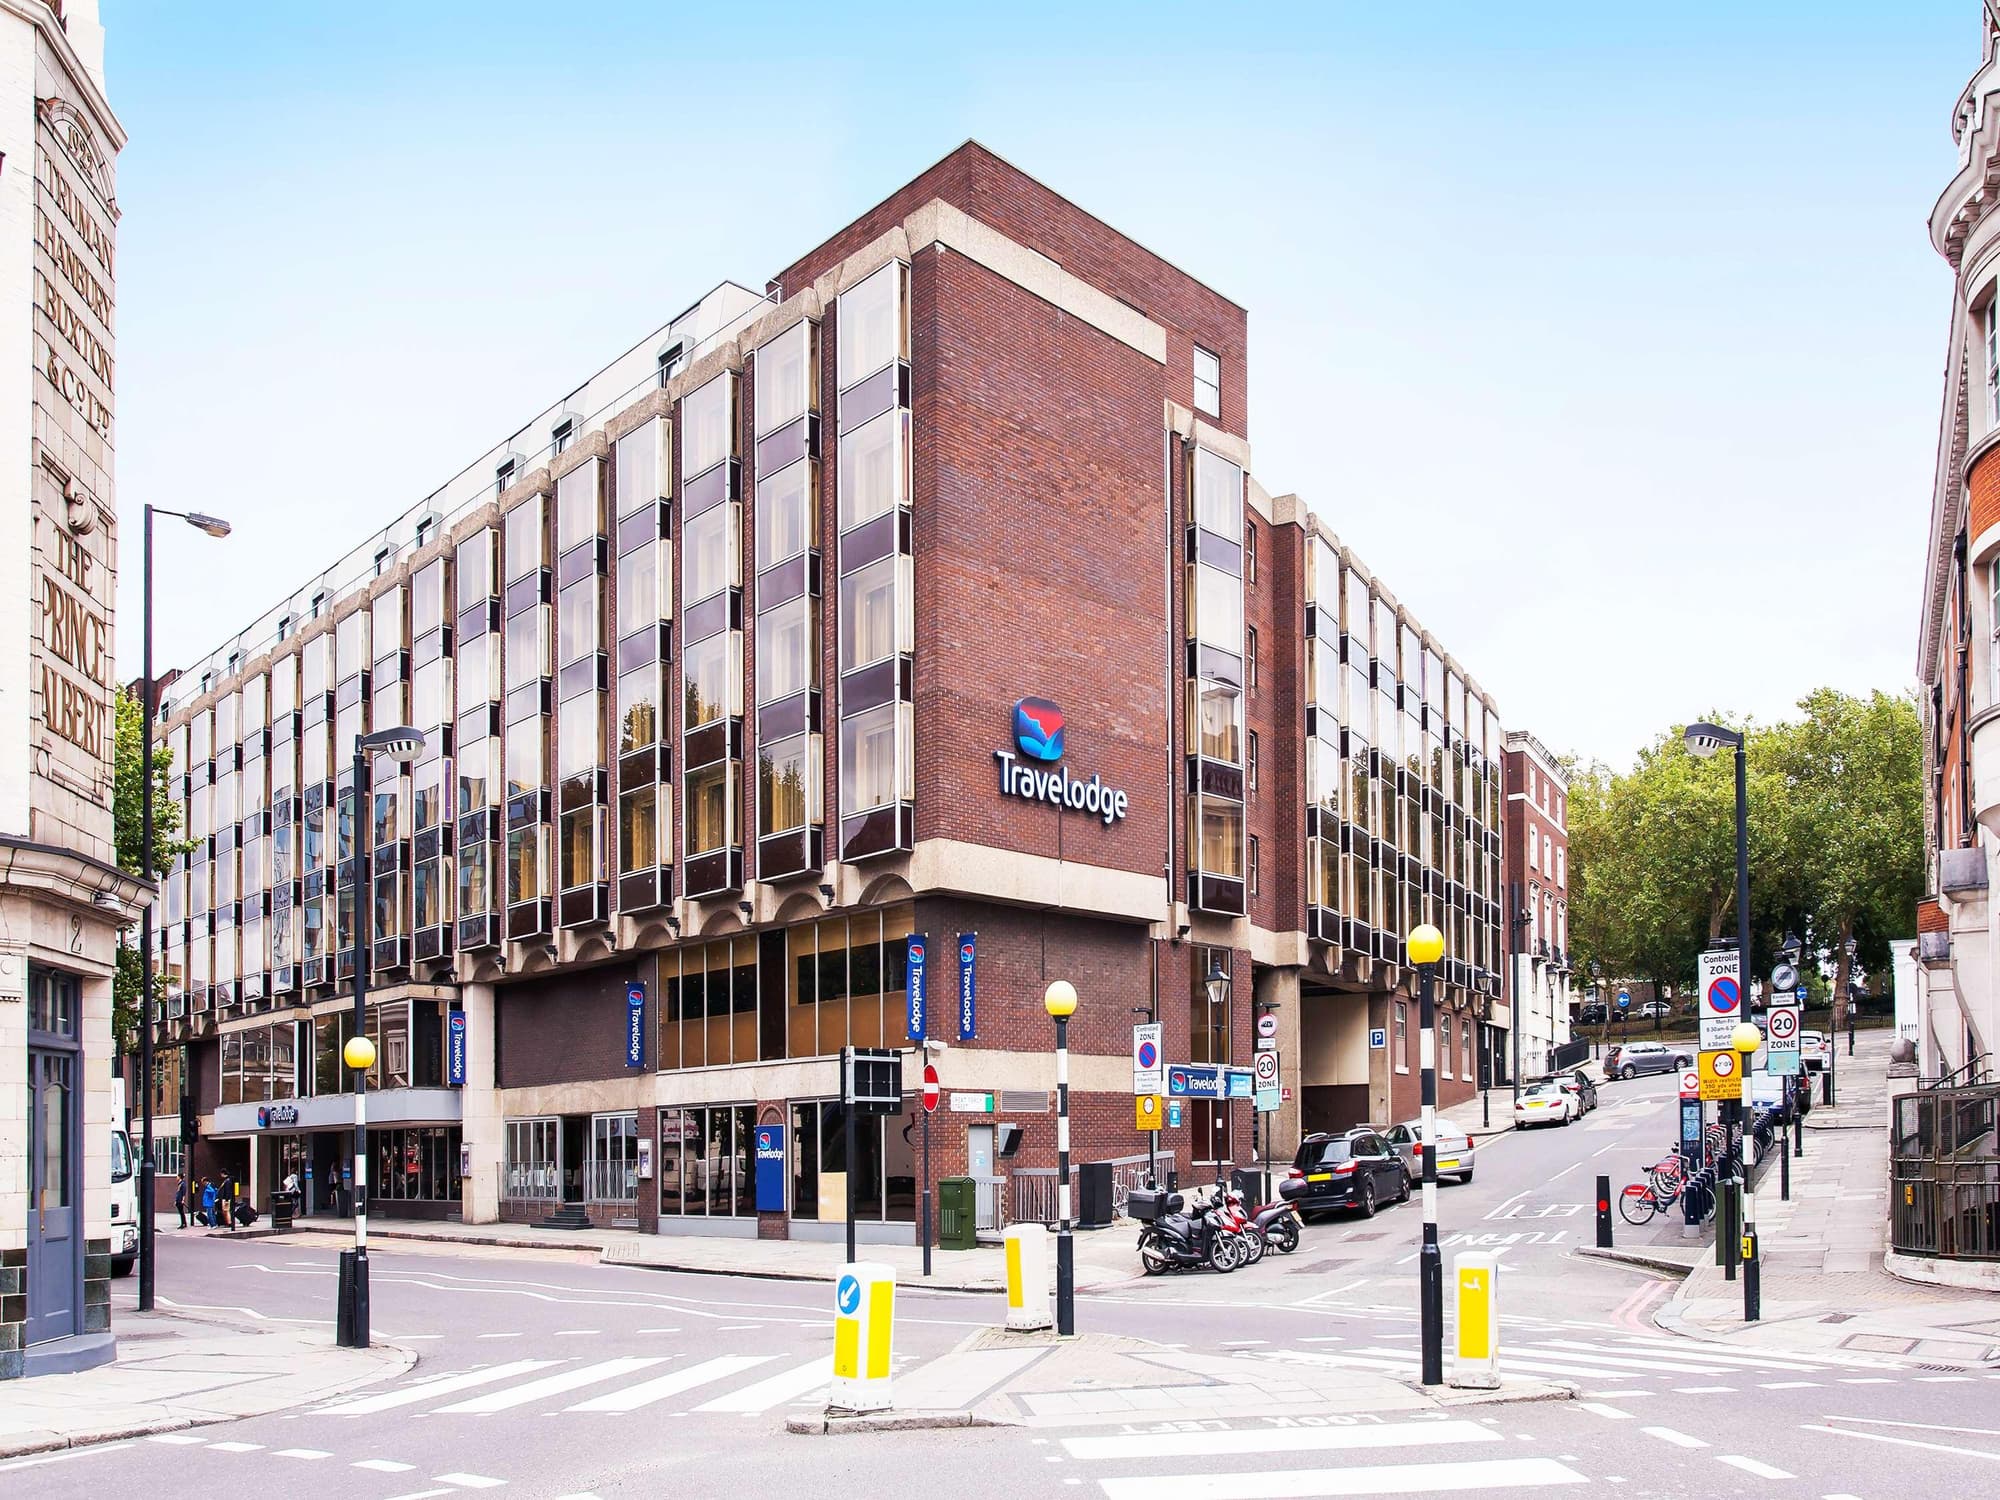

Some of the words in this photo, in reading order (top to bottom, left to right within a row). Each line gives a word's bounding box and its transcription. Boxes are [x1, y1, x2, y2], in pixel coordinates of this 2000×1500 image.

[44, 158, 113, 280] TRUMAN
[43, 217, 112, 328] HANBURY
[44, 280, 113, 394] BUXTON
[54, 525, 94, 595] THE
[42, 575, 106, 688] PRINCE
[42, 663, 106, 759] ALBERT
[995, 750, 1129, 825] Travelodge
[70, 914, 82, 955] 2
[1703, 954, 1740, 964] Controlle
[1710, 964, 1738, 975] ZONE
[912, 966, 923, 1033] Travelodge
[962, 965, 972, 1032] Travelodge
[631, 1007, 641, 1062] Travelodge
[1140, 1033, 1155, 1041] ZONE
[1774, 1017, 1793, 1030] 20
[1374, 1032, 1382, 1044] P
[1770, 1040, 1796, 1049] ZONE
[453, 1032, 463, 1079] Travelodge
[1259, 1061, 1273, 1072] 20
[1187, 1075, 1227, 1091] Travelode
[1258, 1080, 1276, 1088] ZONE
[756, 1148, 783, 1161] Travelodge
[1119, 1420, 1232, 1435] LEFT
[1261, 1415, 1385, 1429] LOOK
